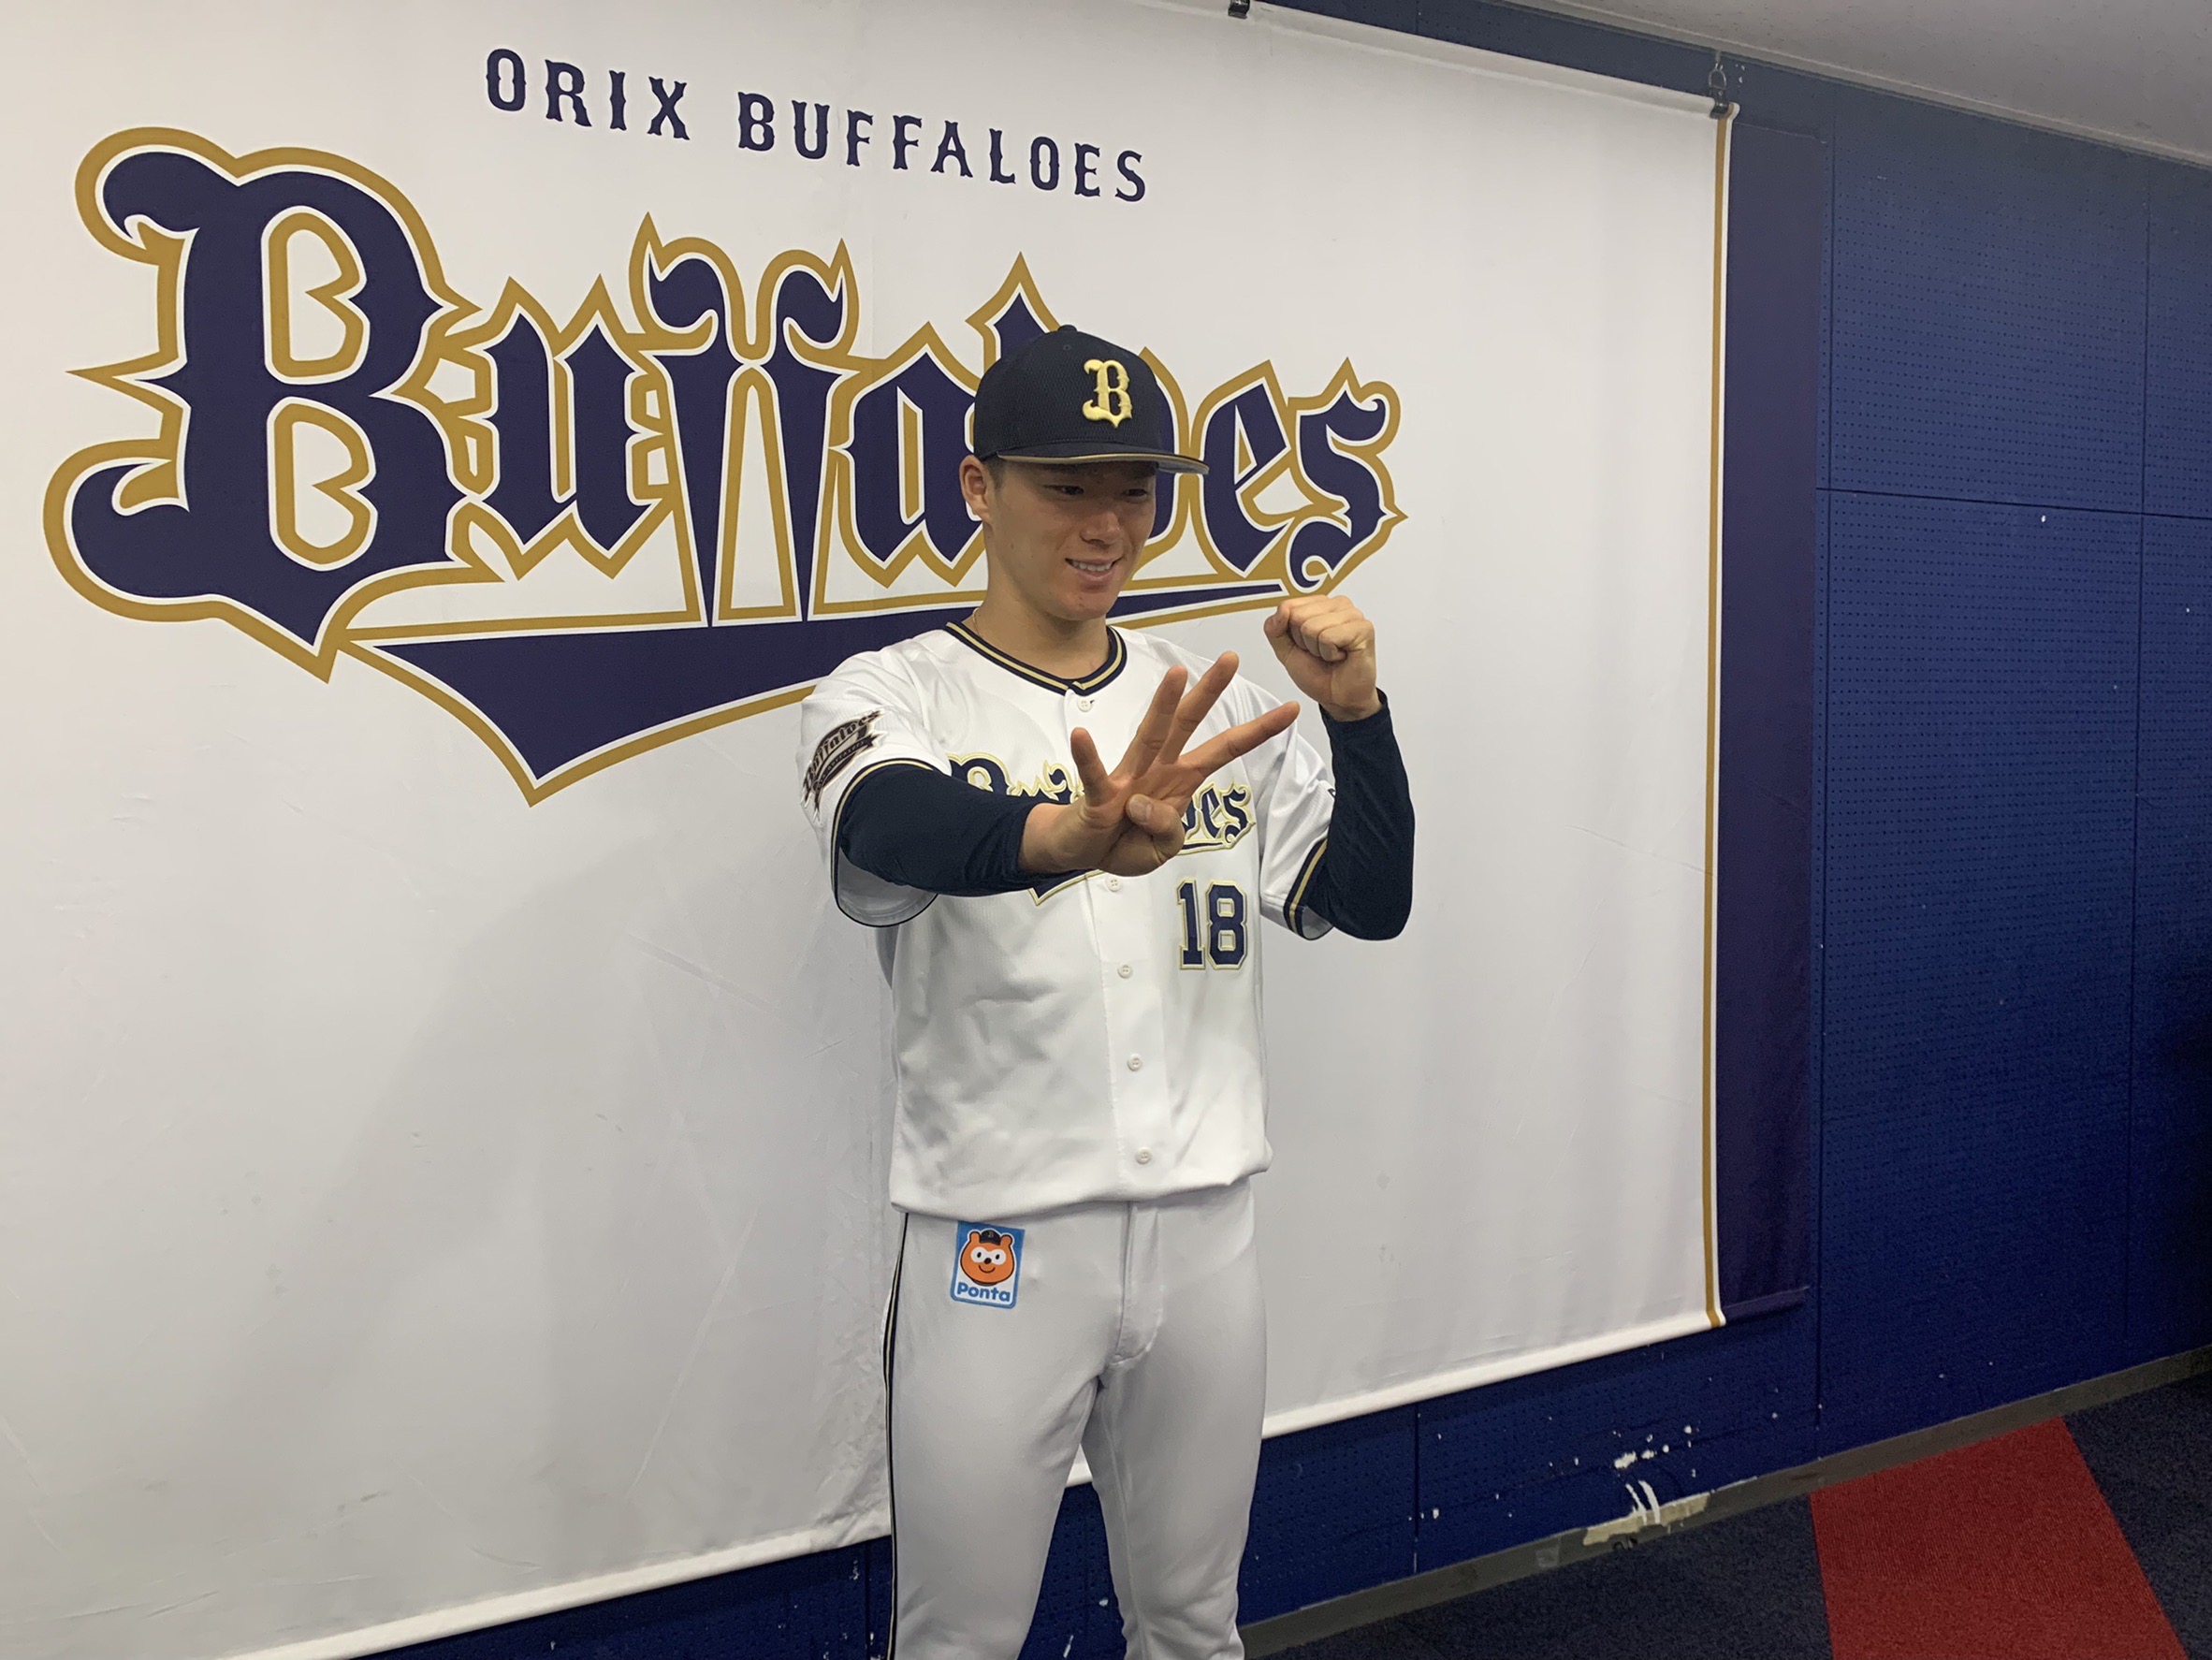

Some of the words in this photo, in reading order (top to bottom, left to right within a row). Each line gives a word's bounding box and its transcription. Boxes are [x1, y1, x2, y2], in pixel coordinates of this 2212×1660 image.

[485, 48, 691, 140] ORIX
[737, 91, 1146, 202] BUFFALOES
[43, 126, 1407, 684] Buffaes
[1082, 358, 1133, 428] B
[1176, 879, 1248, 970] 18
[956, 1281, 1011, 1302] Ponta
